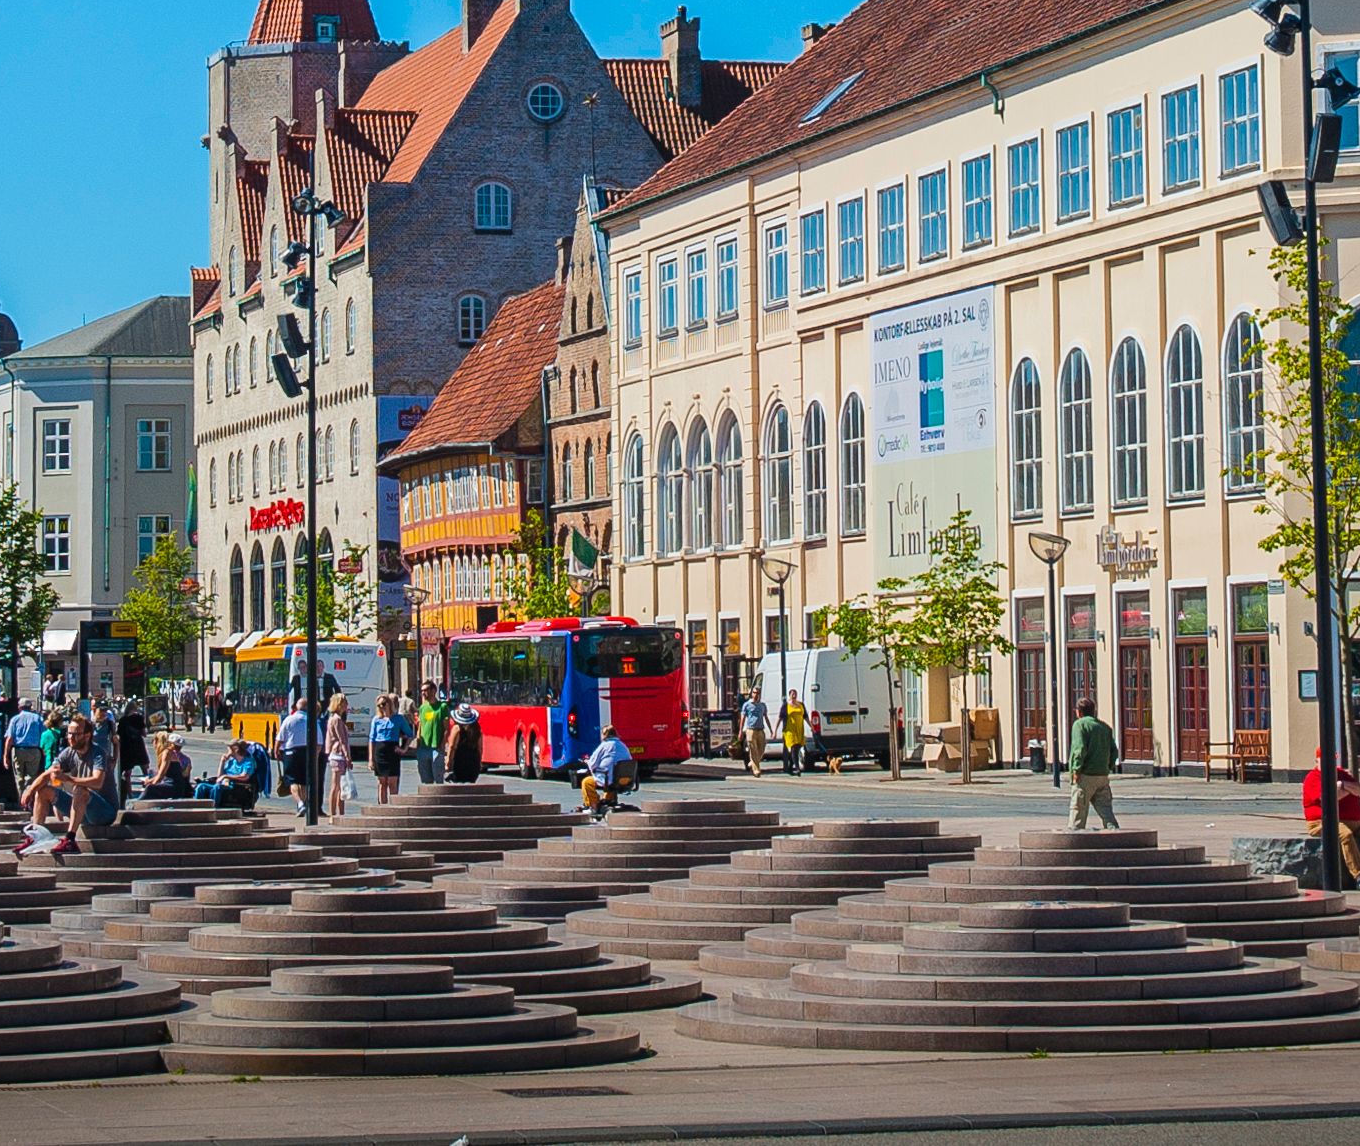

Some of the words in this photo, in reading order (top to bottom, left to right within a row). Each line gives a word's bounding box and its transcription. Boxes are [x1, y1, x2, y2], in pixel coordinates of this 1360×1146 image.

[943, 306, 953, 326] PÅ
[962, 306, 976, 323] SAL
[874, 356, 911, 385] IMENO
[896, 480, 919, 516] Café
